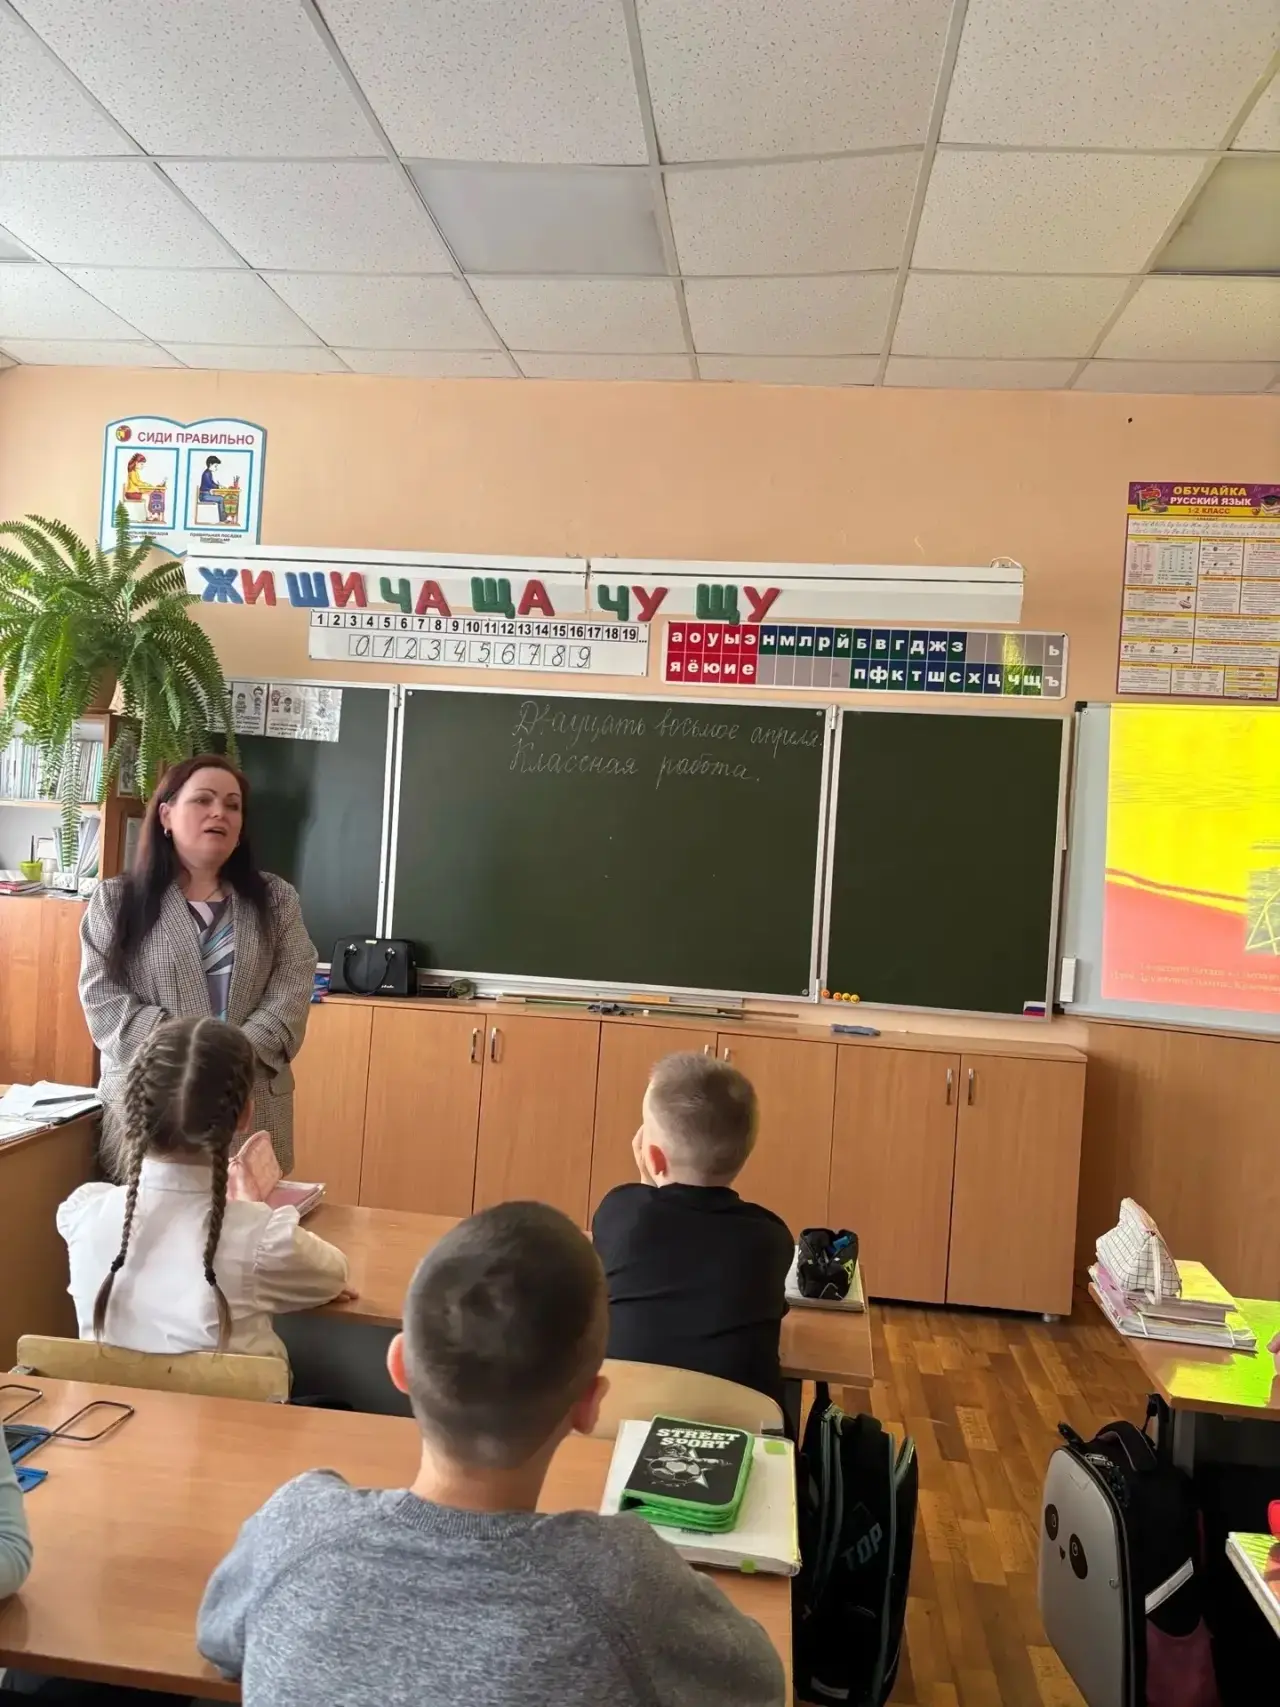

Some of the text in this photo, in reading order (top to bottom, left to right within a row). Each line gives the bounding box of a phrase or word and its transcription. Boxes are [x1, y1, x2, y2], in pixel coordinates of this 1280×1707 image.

[138, 432, 254, 445] СИДИ ПРАВИЛЬНО
[1173, 485, 1247, 496] ОБУЧАЙКА
[1170, 496, 1252, 506] РУССКИЙ ЯЗЫК
[198, 566, 781, 625] ЖИ ШИ ЧА ЩА ЧУ ЩУ
[317, 615, 323, 624] 1
[333, 615, 340, 625] 2
[350, 616, 357, 626] 3
[367, 617, 374, 626] 4
[384, 618, 390, 627] 5
[401, 618, 407, 628] 6
[418, 619, 424, 629] 7
[435, 620, 441, 630] 8
[452, 621, 459, 631] 9
[466, 621, 480, 632] 10
[485, 622, 496, 633] 11
[501, 623, 514, 634] 12
[518, 624, 531, 635] 13
[535, 625, 548, 636] 14
[553, 626, 566, 636] 15
[570, 627, 583, 637] 16
[587, 627, 601, 638] 17
[605, 628, 618, 639] 18
[356, 636, 590, 667] 0 1 2 3 4 5 6 7 8 9
[654, 707, 740, 740] восьмое
[510, 737, 761, 790] Классная работа.
[656, 1429, 740, 1441] STREET
[660, 1438, 730, 1449] SPORT
